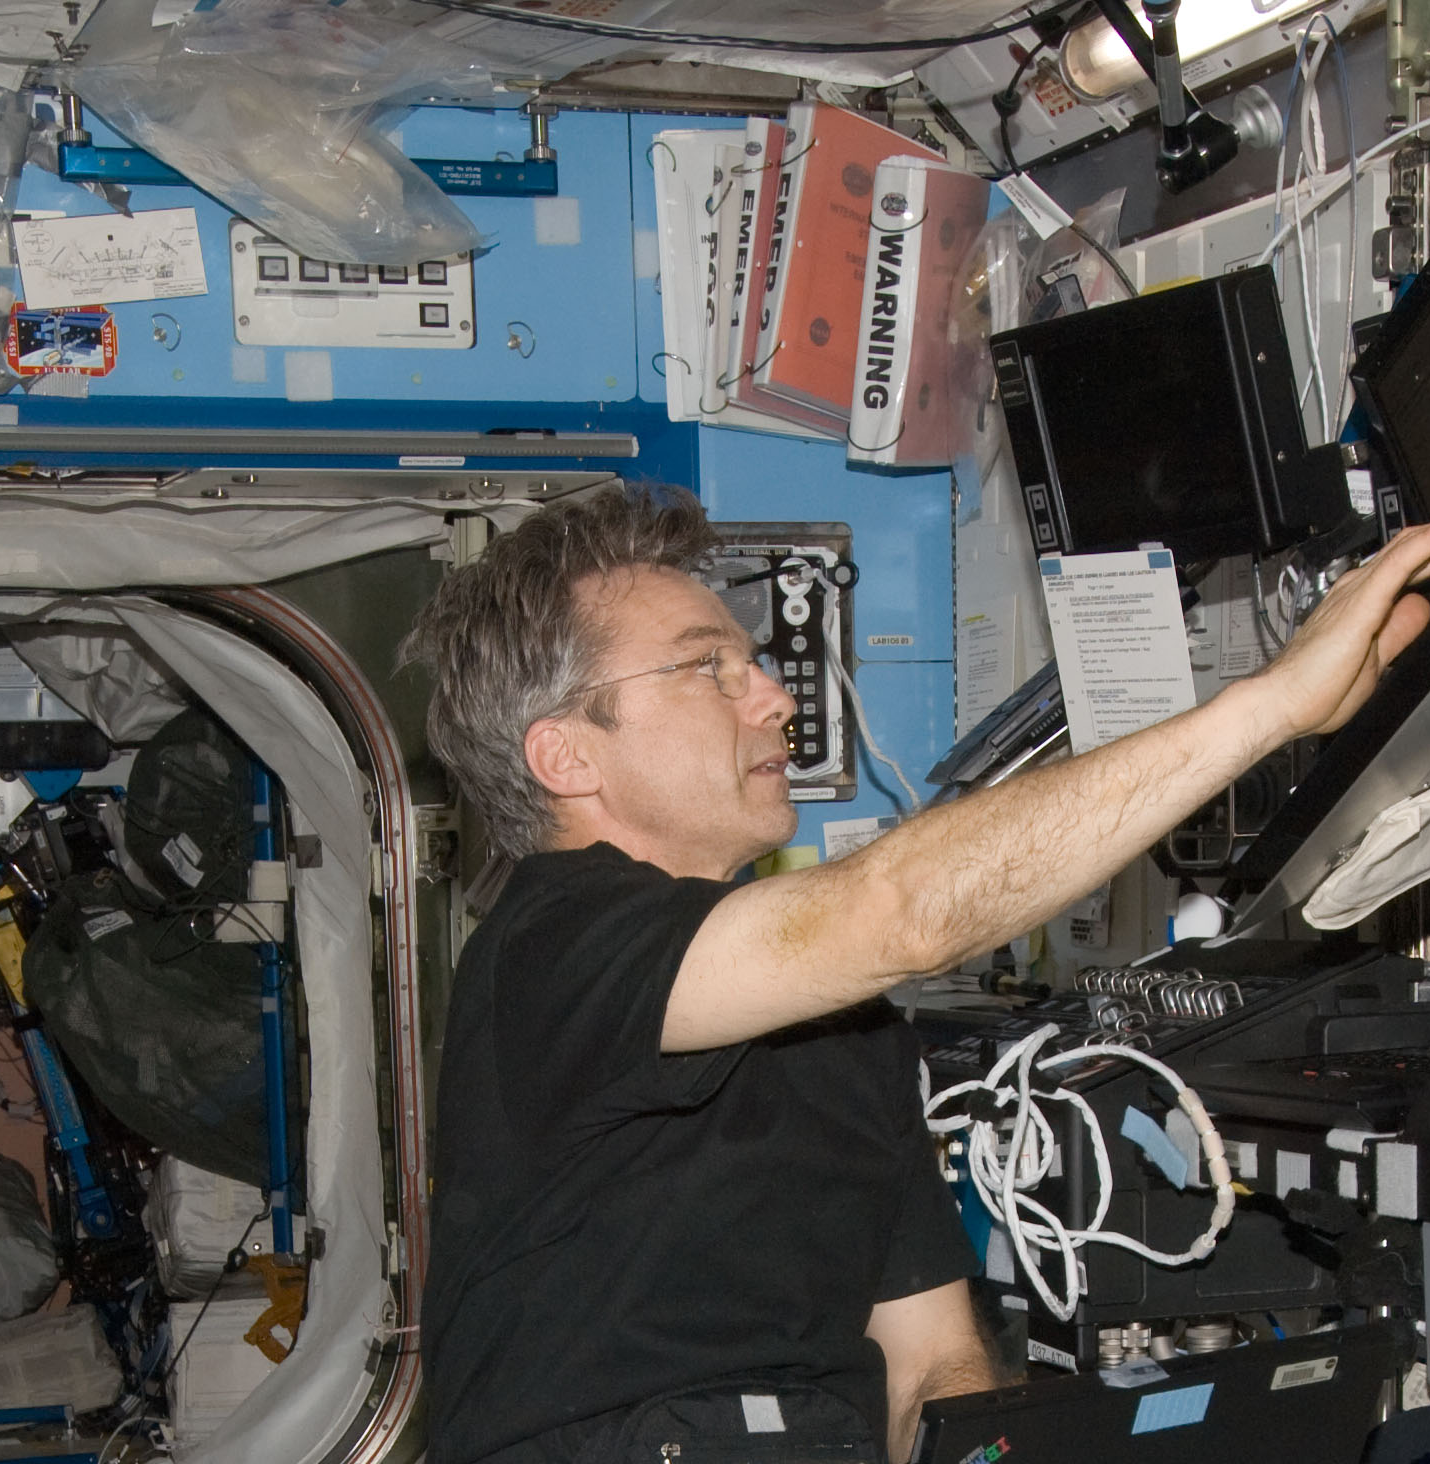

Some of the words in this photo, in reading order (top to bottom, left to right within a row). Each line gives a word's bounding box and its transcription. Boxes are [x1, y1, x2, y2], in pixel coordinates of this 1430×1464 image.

[731, 189, 754, 297] EMER
[761, 171, 791, 293] EMER
[729, 310, 739, 328] 1
[757, 307, 771, 331] 2
[861, 232, 904, 411] WARNING
